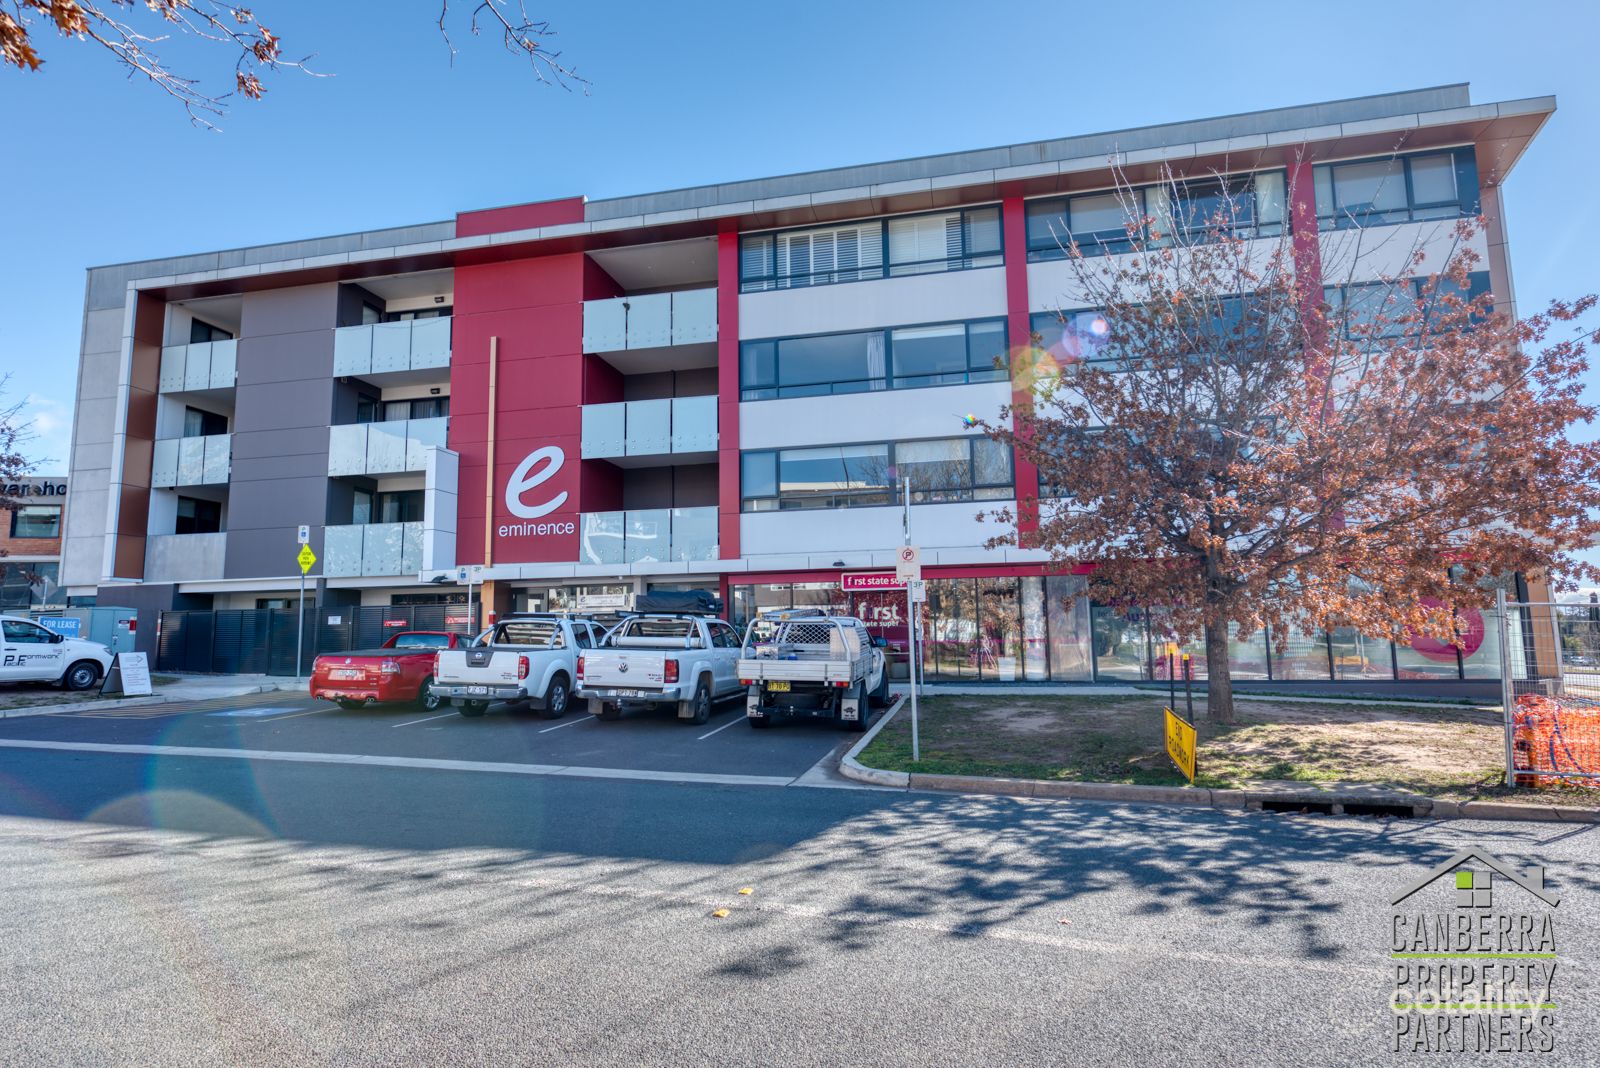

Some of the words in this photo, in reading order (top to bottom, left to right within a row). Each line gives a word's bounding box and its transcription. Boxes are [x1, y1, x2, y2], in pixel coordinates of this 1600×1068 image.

[498, 522, 575, 537] eminence
[867, 576, 889, 585] state
[890, 576, 908, 587] sup
[43, 620, 56, 628] FOR
[58, 620, 76, 629] LEASE
[879, 620, 899, 628] super
